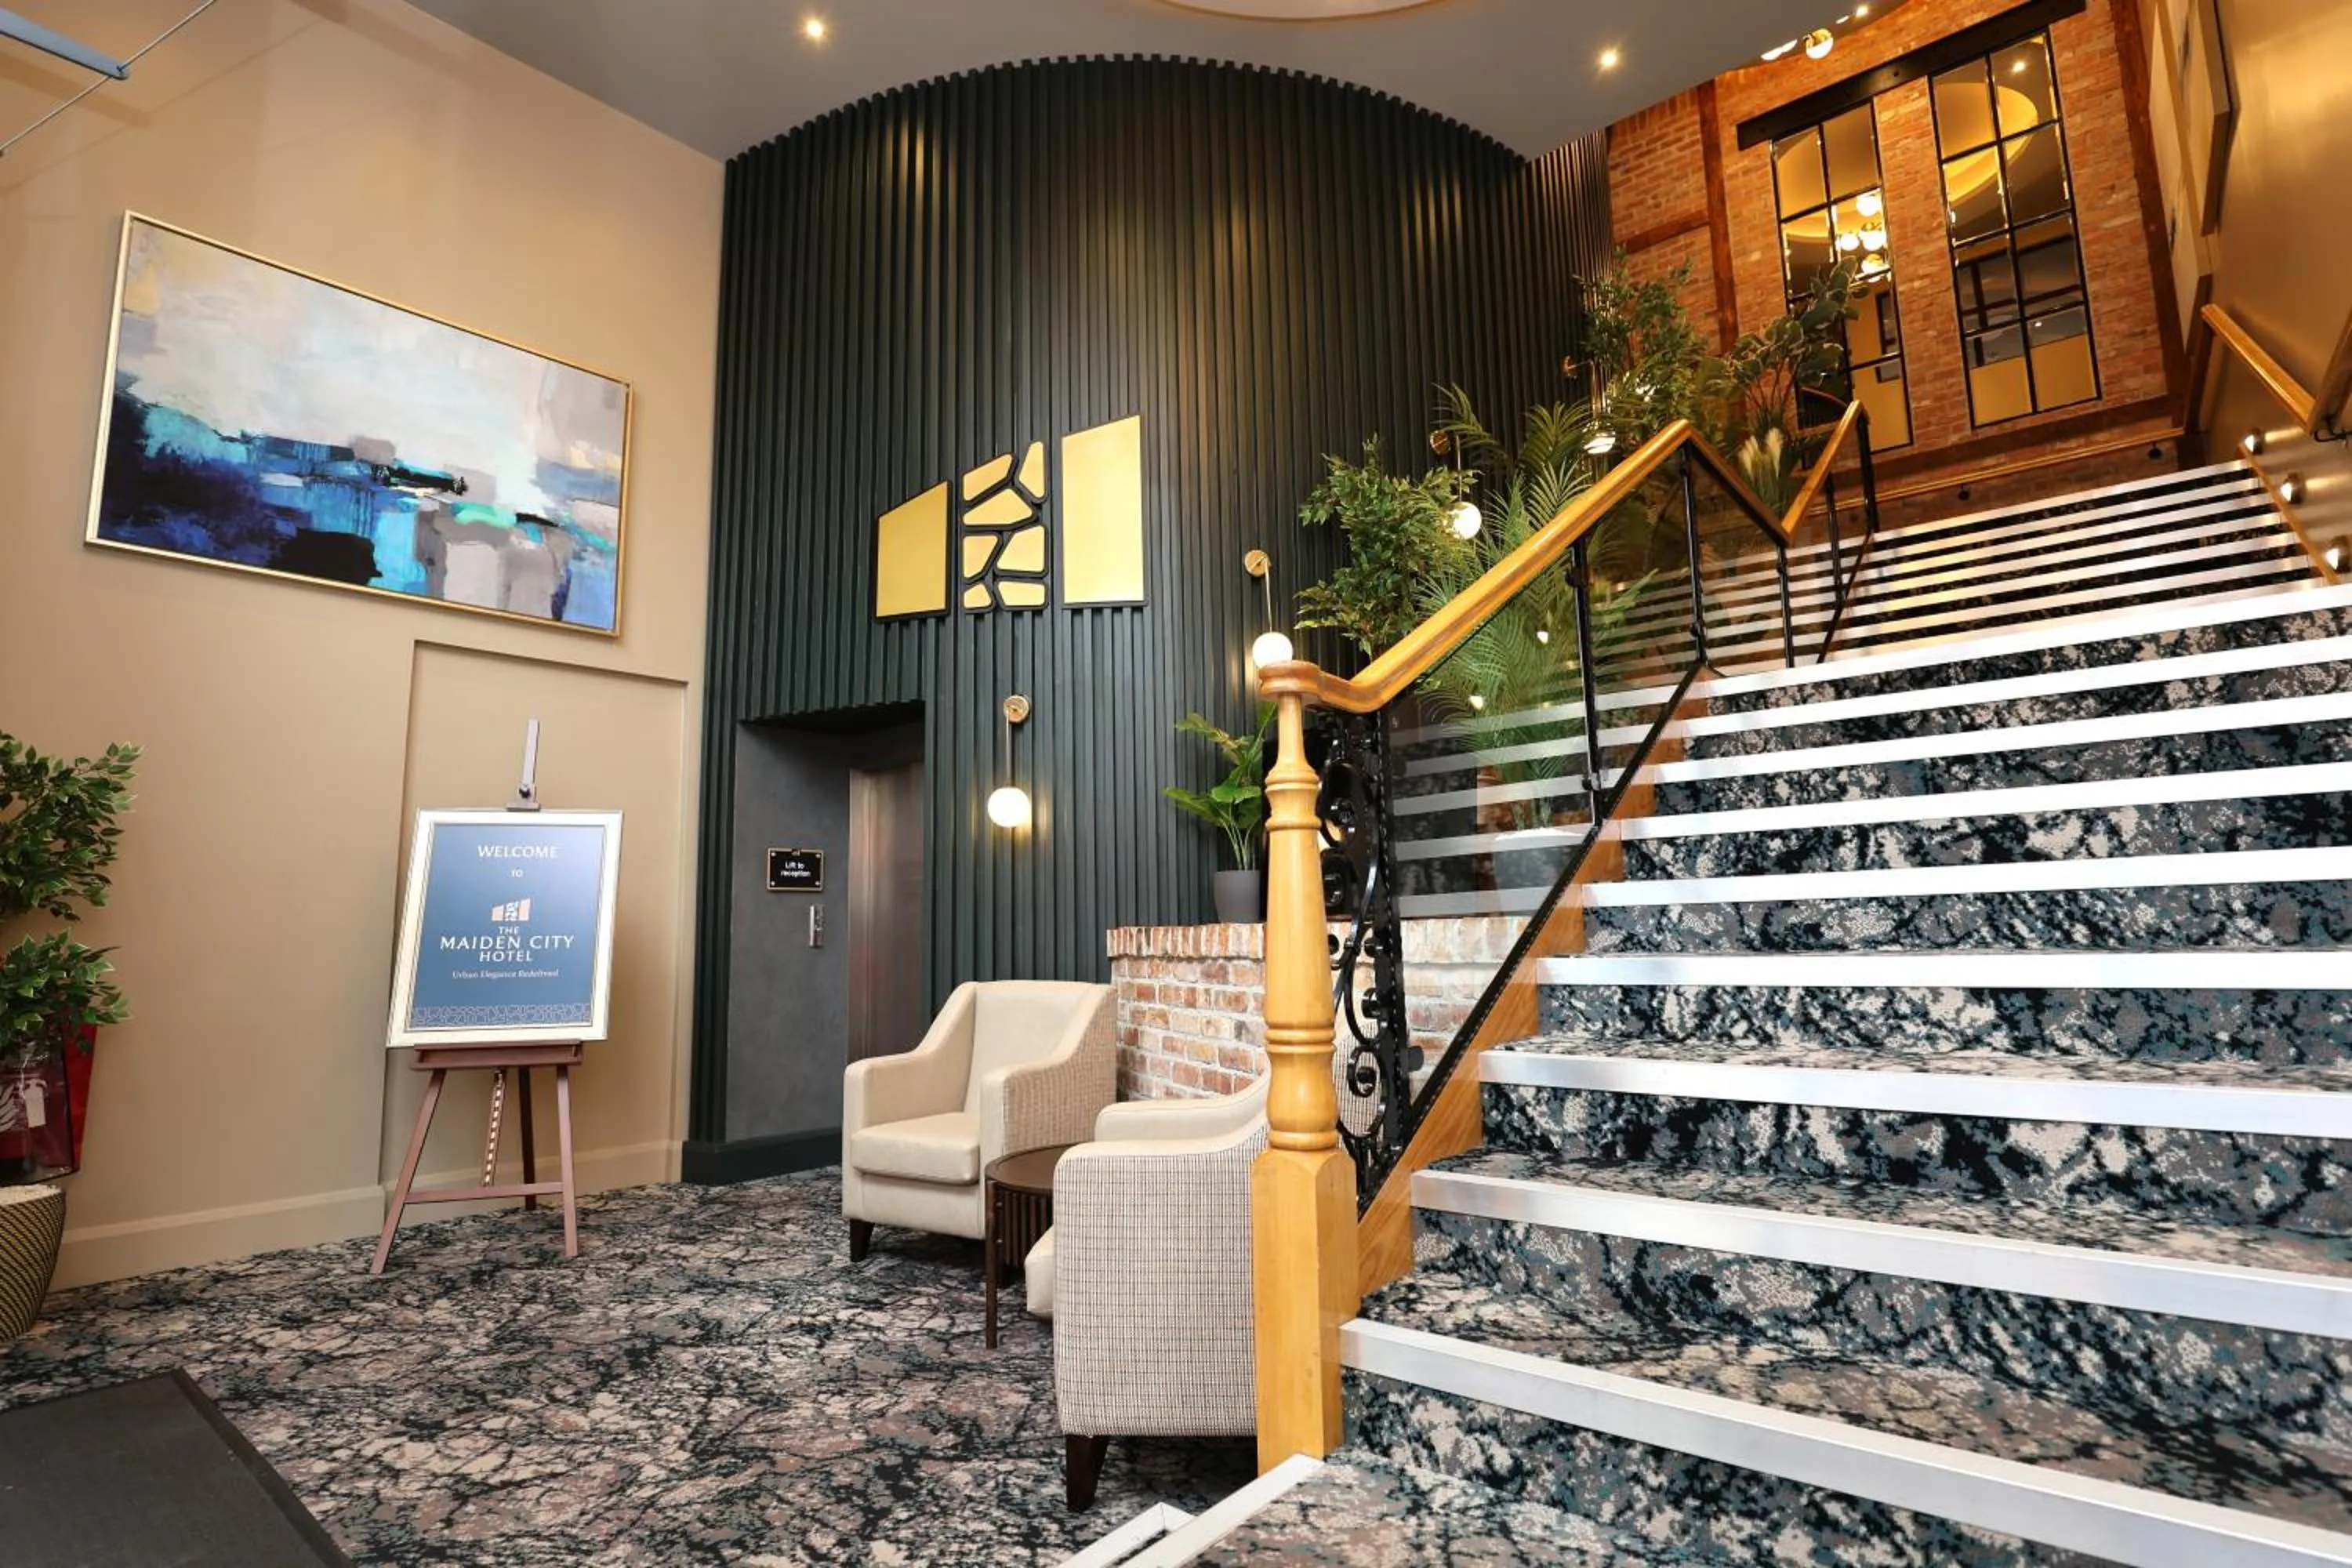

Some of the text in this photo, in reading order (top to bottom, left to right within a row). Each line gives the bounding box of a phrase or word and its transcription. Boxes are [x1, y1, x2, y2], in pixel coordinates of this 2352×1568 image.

[477, 845, 557, 858] WELCOME
[440, 935, 574, 950] MAIDEN CITY
[479, 951, 533, 962] HOTEL
